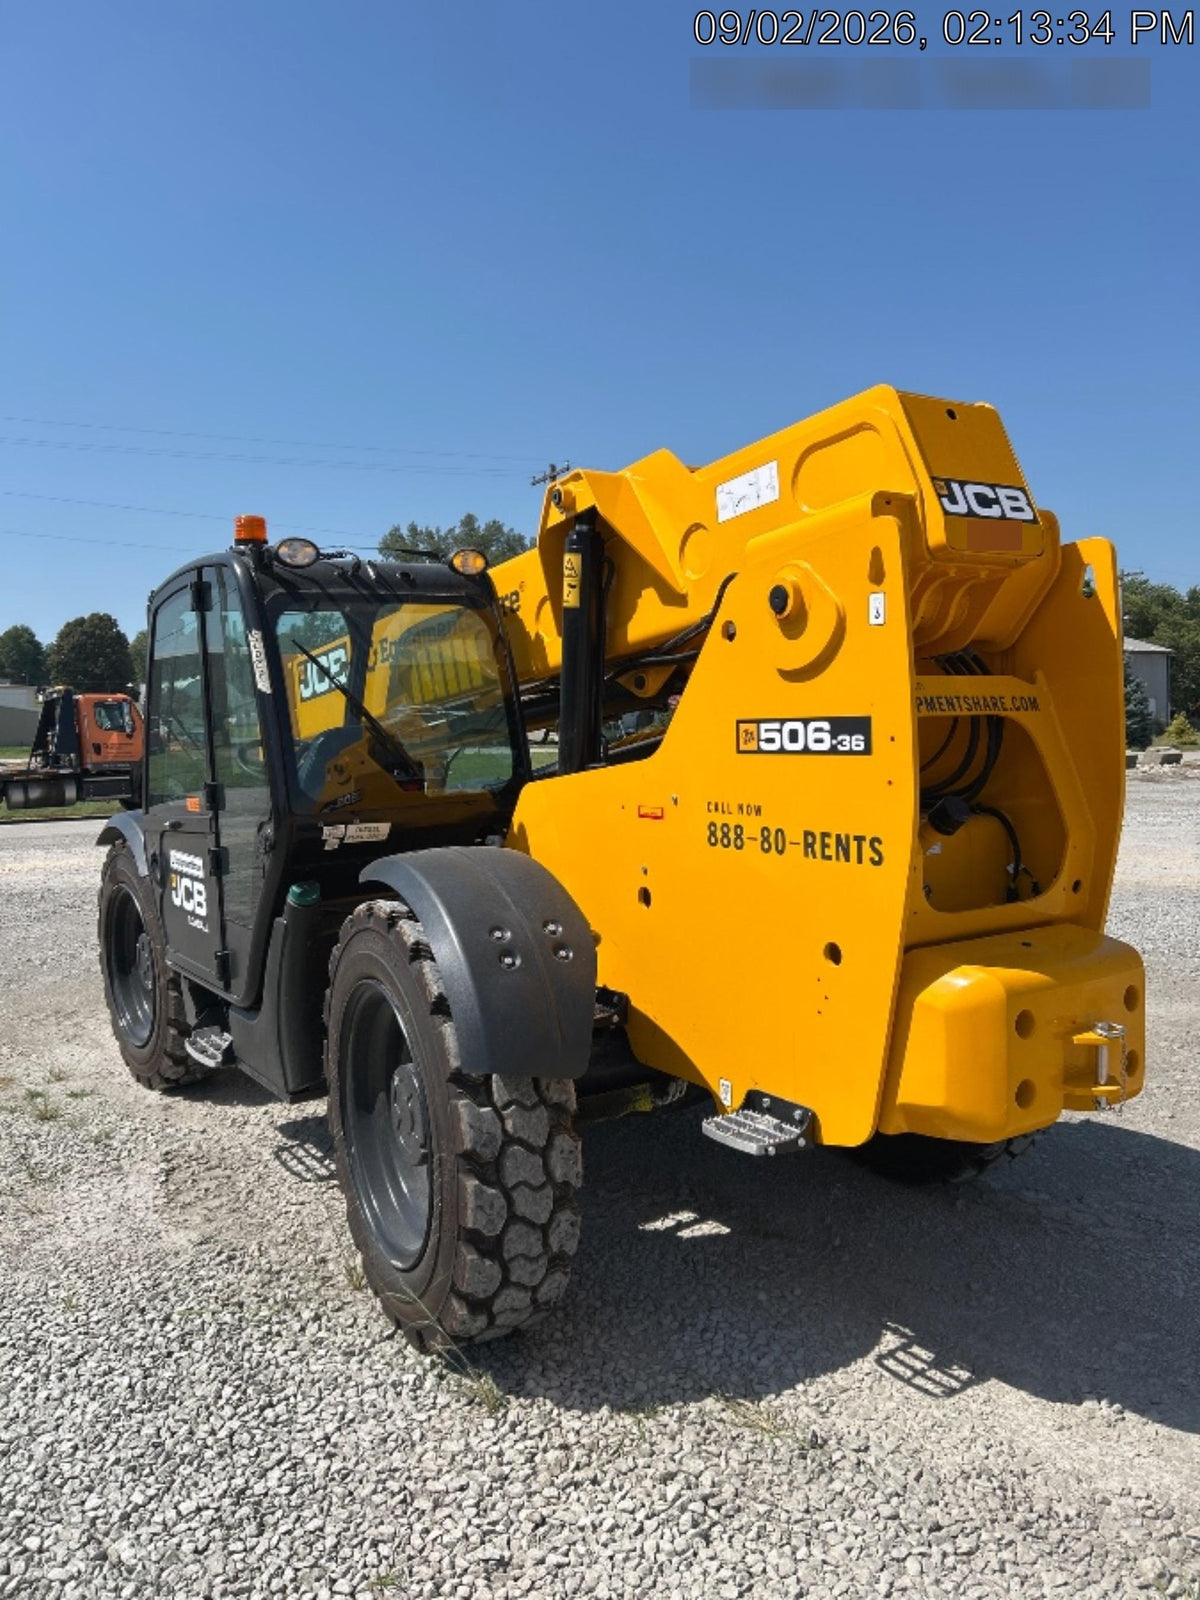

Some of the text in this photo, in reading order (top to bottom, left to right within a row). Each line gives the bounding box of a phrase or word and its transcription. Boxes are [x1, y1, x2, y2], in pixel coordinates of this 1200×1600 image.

[941, 482, 1034, 520] JCB
[914, 695, 1040, 713] PMENTSHARE.COM
[707, 801, 762, 817] CALL NOW
[707, 821, 884, 867] 888-80-RENTS
[171, 874, 207, 917] JCB
